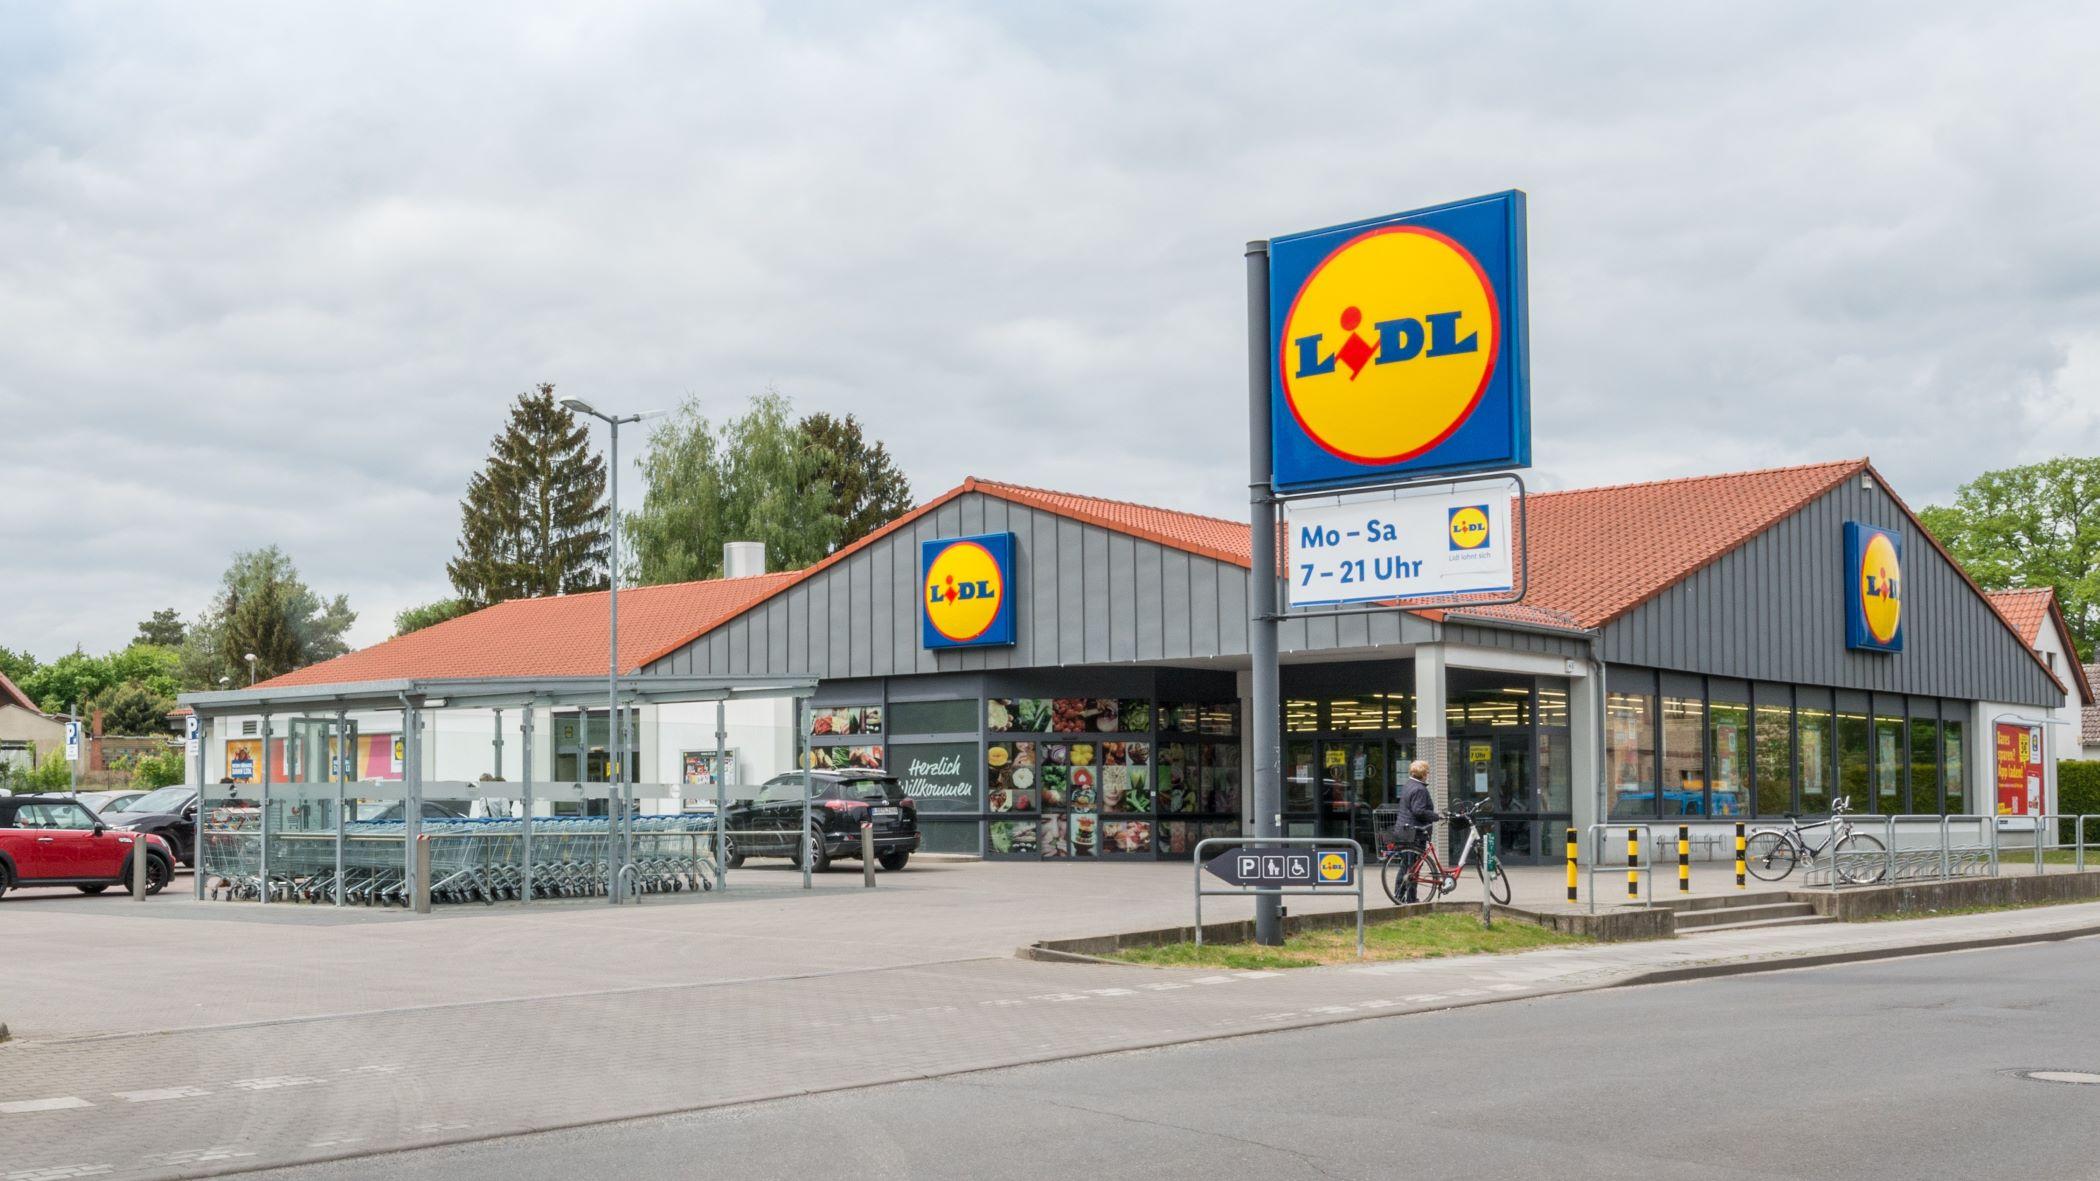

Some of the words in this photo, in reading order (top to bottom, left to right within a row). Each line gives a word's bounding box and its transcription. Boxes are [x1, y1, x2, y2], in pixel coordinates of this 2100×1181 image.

[1301, 524, 1341, 549] Mo
[1367, 519, 1398, 544] Sa
[1300, 563, 1314, 587] 7
[1340, 559, 1366, 583] 21
[1374, 554, 1423, 581] Uhr
[66, 722, 75, 744] P
[908, 754, 962, 777] Herzlich
[1242, 859, 1256, 876] P
